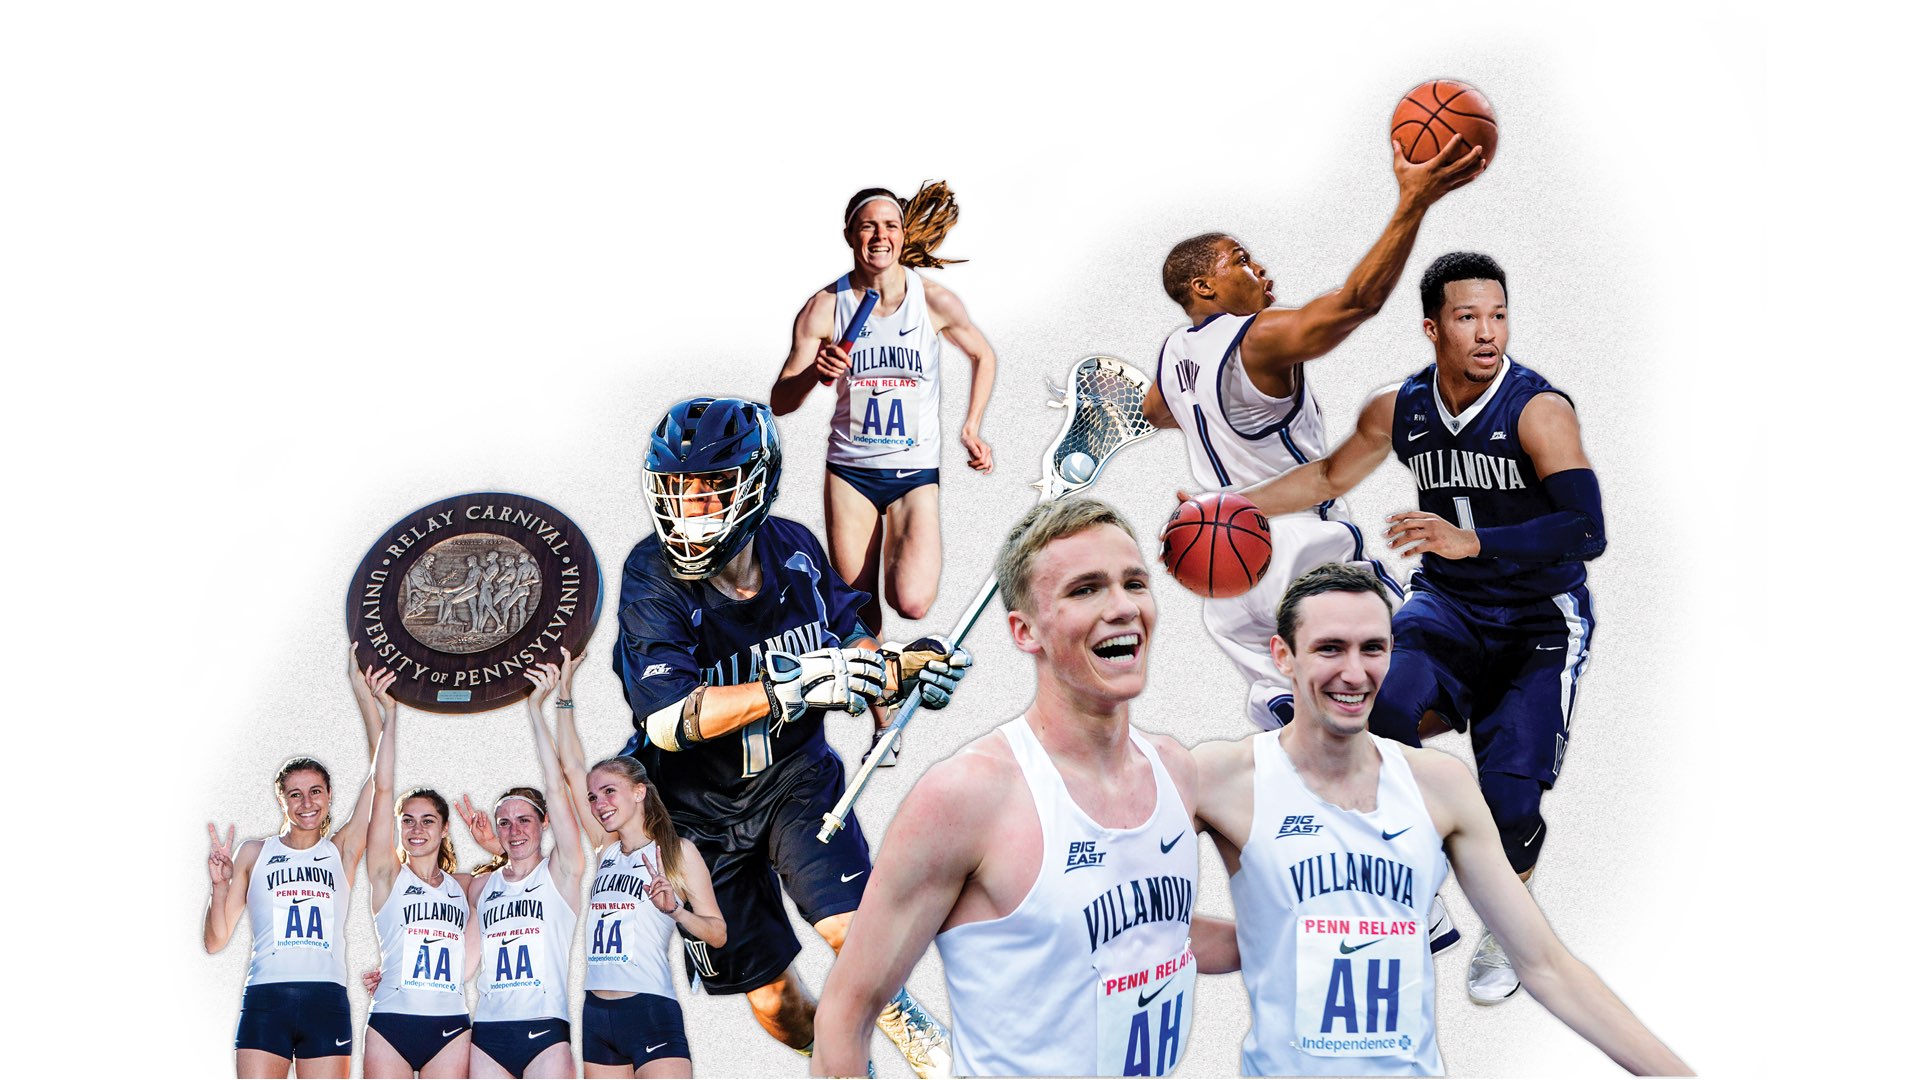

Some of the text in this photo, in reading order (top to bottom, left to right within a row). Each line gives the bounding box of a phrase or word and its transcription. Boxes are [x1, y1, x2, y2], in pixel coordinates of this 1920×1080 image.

[862, 398, 905, 436] AA
[853, 435, 904, 445] Independence
[1408, 449, 1526, 491] VILLANOVA
[389, 505, 569, 559] RELAY CARNIVAL
[363, 565, 580, 687] UNIVERSITY OF PENNSYLVANIA
[1279, 824, 1324, 834] EAST
[1283, 815, 1314, 825] BIG
[1066, 852, 1107, 866] EAST
[1069, 841, 1096, 853] BIG
[267, 867, 335, 891] VILLANOVA
[1289, 852, 1414, 909] VILLANOVA
[301, 890, 330, 898] RELAYS
[285, 905, 323, 940] AA
[403, 902, 464, 930] VILLANOVA
[483, 900, 544, 930] VILLANOVA
[1083, 876, 1192, 954] VILLANOVA
[1305, 919, 1416, 936] PENN RELAYS
[408, 928, 459, 940] PENN RELAYS
[510, 927, 540, 935] RELAYS
[592, 920, 622, 954] AA
[413, 945, 450, 981] AA
[496, 945, 533, 981] AA
[1106, 949, 1193, 996] PENN RELAYS
[405, 980, 449, 989] Indepdence
[490, 980, 532, 989] Independence
[1320, 959, 1400, 1033] AH
[1123, 991, 1184, 1077] AH
[1302, 1037, 1395, 1052] Independence
